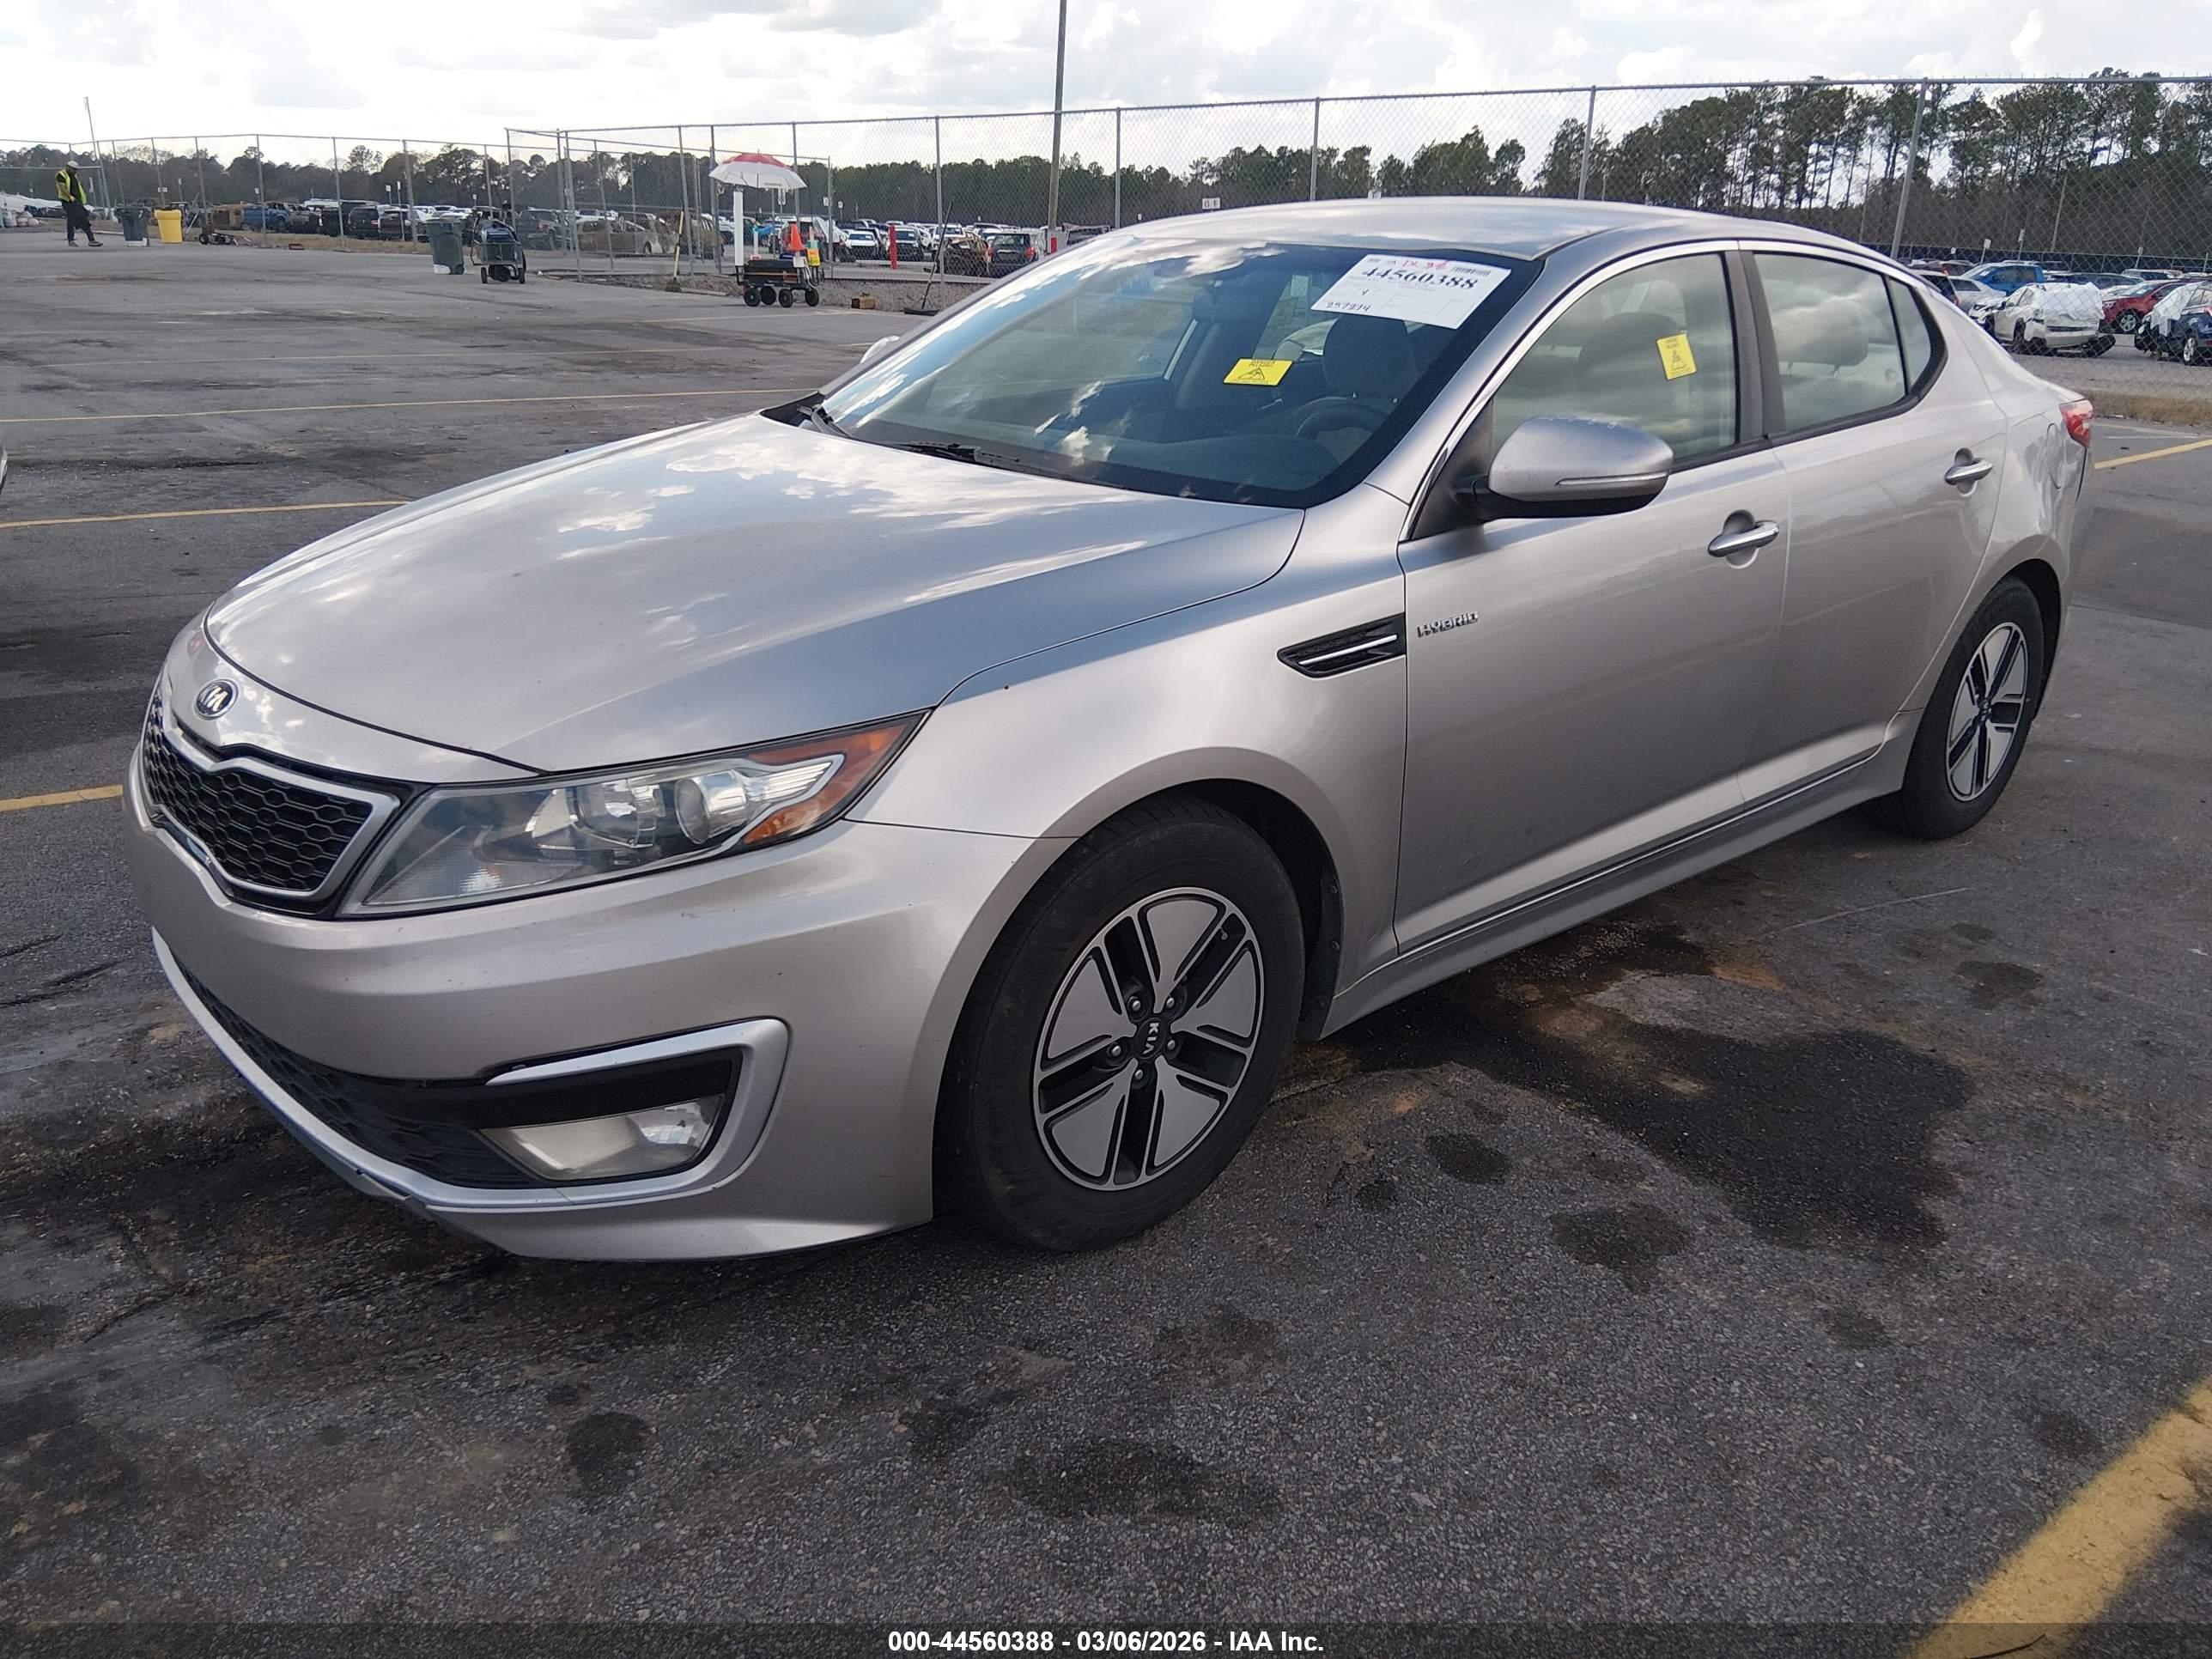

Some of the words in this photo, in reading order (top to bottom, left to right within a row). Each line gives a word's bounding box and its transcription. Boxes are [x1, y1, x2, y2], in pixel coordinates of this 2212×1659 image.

[1362, 266, 1479, 289] 44560388
[1417, 611, 1479, 638] HYBRID
[1143, 1023, 1159, 1054] KIA
